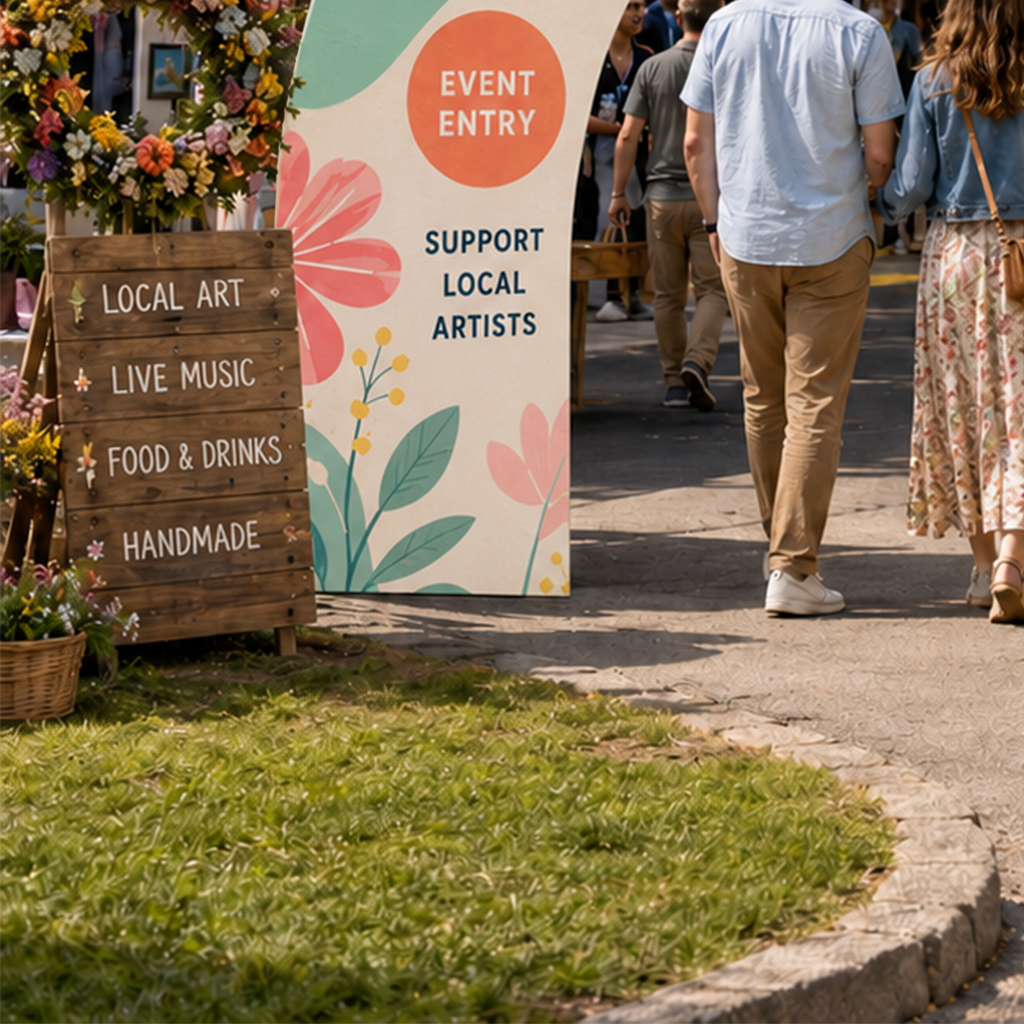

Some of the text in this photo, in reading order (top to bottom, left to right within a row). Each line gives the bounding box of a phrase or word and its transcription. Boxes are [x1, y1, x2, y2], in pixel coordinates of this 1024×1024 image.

[440, 70, 536, 96] EVENT
[439, 109, 536, 137] ENTRY
[425, 228, 545, 255] SUPPORT
[102, 278, 244, 314] LOCAL ART
[443, 270, 526, 297] LOCAL
[432, 311, 537, 340] ARTISTS
[111, 358, 256, 394] LIVE MUSIC
[108, 435, 283, 477] FOOD & DRINKS
[123, 520, 260, 561] HANDMADE
